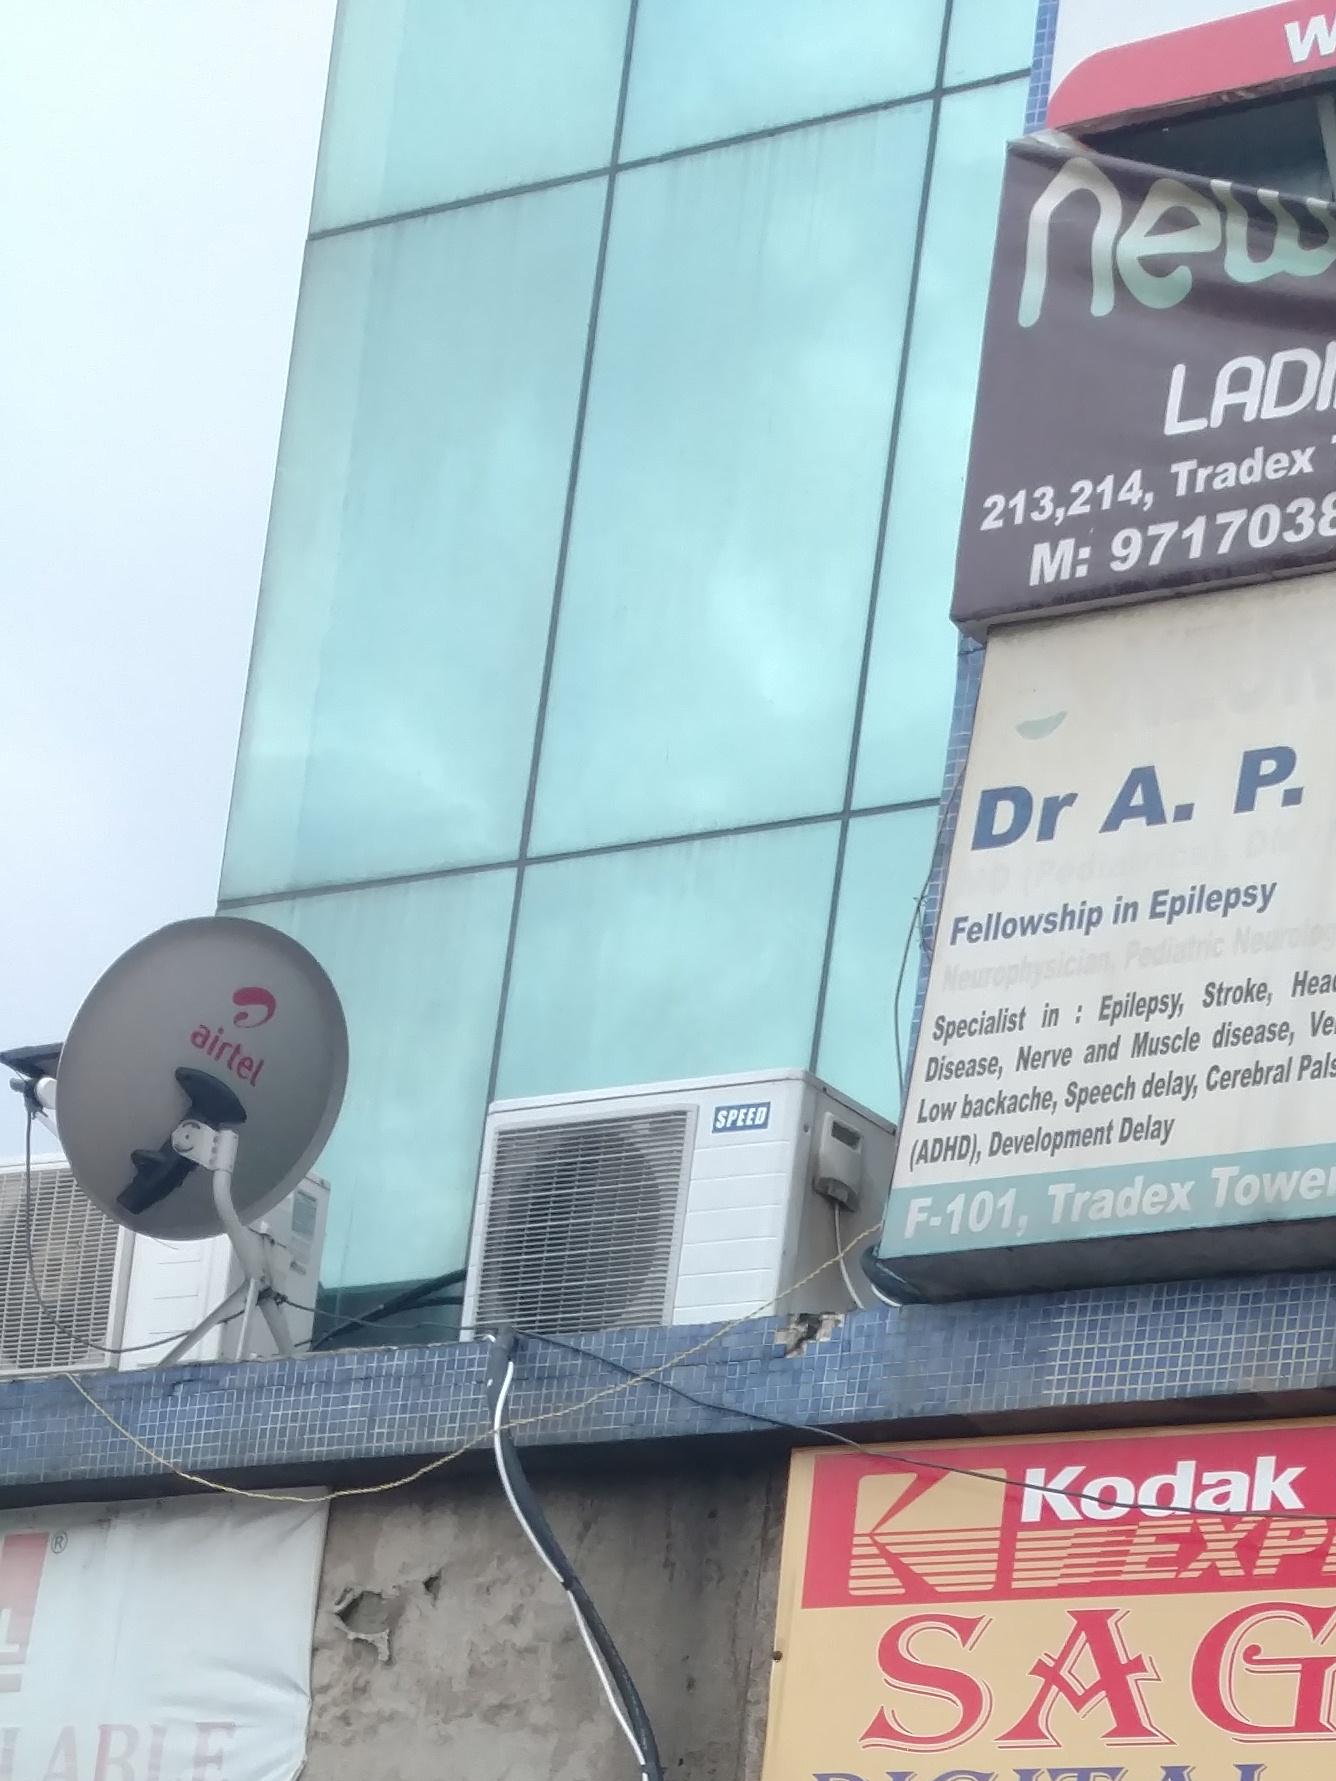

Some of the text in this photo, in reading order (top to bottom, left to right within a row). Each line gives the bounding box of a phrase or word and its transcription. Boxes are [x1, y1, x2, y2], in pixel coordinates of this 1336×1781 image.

[980, 468, 1154, 531] 213,214,
[1170, 445, 1316, 497] Tradex
[1028, 537, 1092, 587] M:
[971, 785, 1080, 851] Dr
[1098, 765, 1196, 834] A.
[1233, 746, 1305, 814] P.
[950, 881, 1278, 946] Fellowship in Epilepsy
[932, 1005, 1027, 1046] Specialist
[1041, 1003, 1060, 1029] in
[1099, 990, 1185, 1027] Epilepsy,
[1202, 977, 1273, 1008] Stroke,
[191, 1024, 264, 1087] airtel
[715, 1106, 767, 1129] SPEED
[903, 1187, 1030, 1239] F-101,
[1048, 1175, 1197, 1224] Tradex
[1020, 1455, 1306, 1523] Kodak
